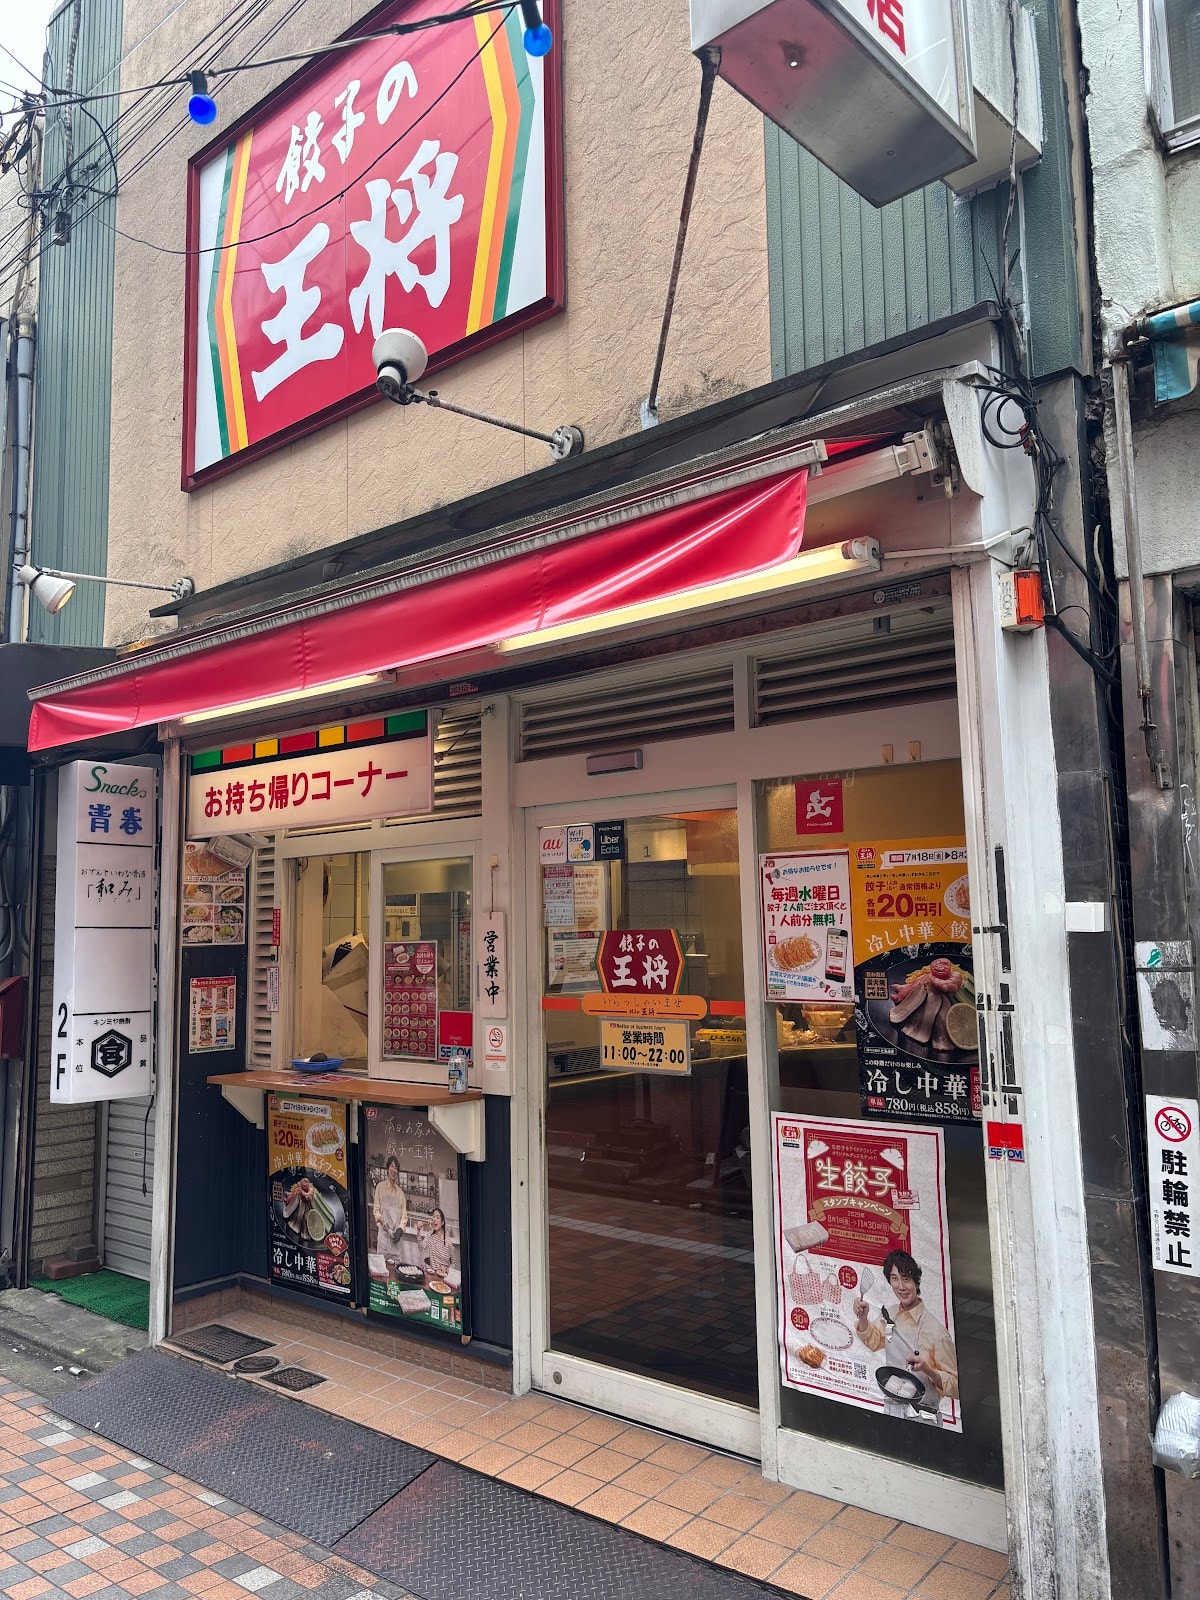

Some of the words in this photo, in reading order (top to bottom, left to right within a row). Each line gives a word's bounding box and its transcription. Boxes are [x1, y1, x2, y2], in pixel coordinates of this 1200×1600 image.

[276, 61, 418, 204] 餃子の
[252, 140, 464, 402] 王将
[83, 765, 147, 798] Snack
[204, 760, 408, 818] お持ち帰りコーナー
[88, 803, 143, 836] 青春
[543, 838, 564, 851] au
[600, 834, 620, 844] Uber
[600, 845, 620, 855] Eats
[771, 885, 840, 902] 毎週水曜日
[865, 881, 886, 892] 餃子
[899, 881, 942, 891] 通常価格より
[866, 898, 875, 917] 各種
[618, 933, 660, 953] 餃子の
[483, 930, 500, 1005] 営業中
[611, 953, 669, 990] 王将
[602, 995, 682, 1008] いらっしゃいませ
[641, 1008, 655, 1016] 王将
[622, 1030, 664, 1046] 営業時間
[441, 1046, 471, 1060] SECOM
[865, 1060, 922, 1069] この時期だけのお楽しみ
[866, 1068, 969, 1101] 冷し中華
[386, 1138, 435, 1160] 餃子の王将
[814, 1156, 897, 1197] 生餃子
[823, 1198, 893, 1216] スタンプキャンペーン
[1161, 1149, 1192, 1268] 駐輪禁止
[273, 1247, 317, 1274] 冷し中華
